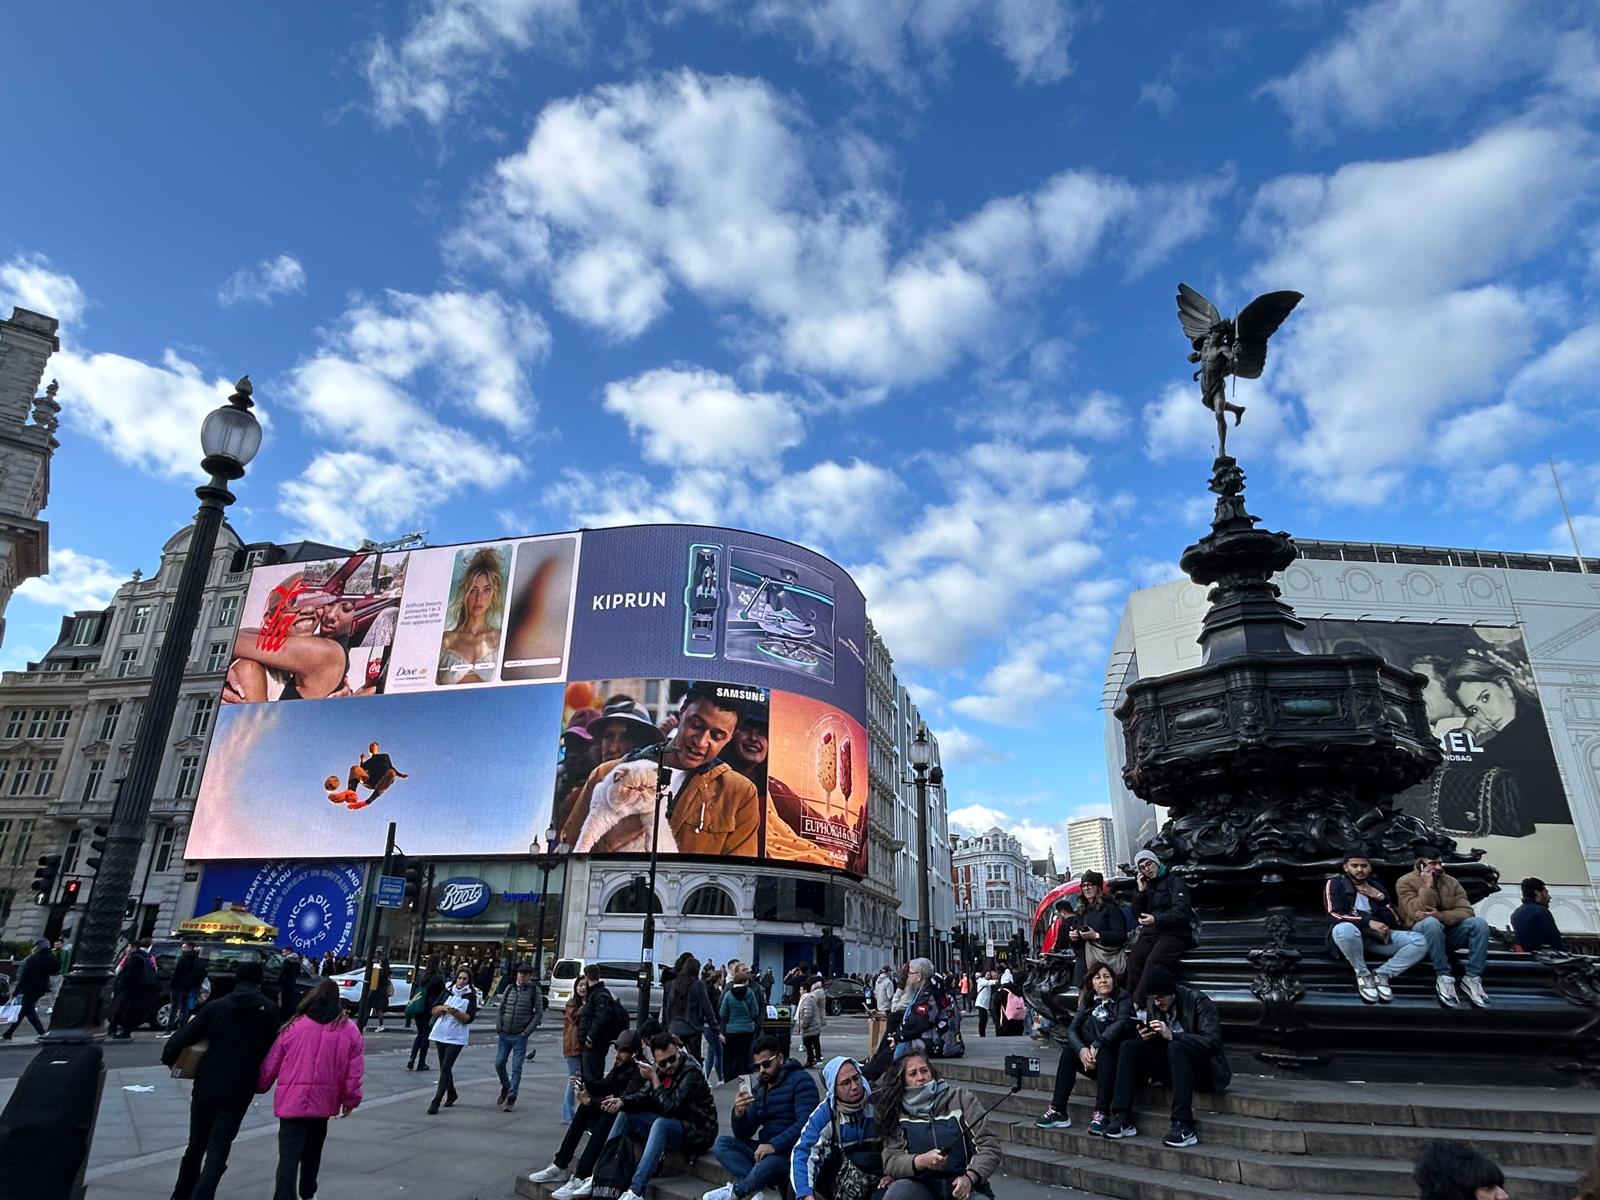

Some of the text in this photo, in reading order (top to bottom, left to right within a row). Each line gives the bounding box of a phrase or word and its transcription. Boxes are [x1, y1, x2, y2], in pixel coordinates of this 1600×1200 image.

[592, 591, 667, 611] KIPRUN
[396, 666, 418, 676] Dove
[716, 687, 766, 702] SAMSUNG
[805, 819, 842, 838] EUPHORIA
[282, 870, 310, 895] GREAT
[310, 869, 320, 877] IN
[321, 869, 350, 894] BRITAIN
[345, 869, 360, 887] AND
[260, 888, 276, 914] WITH
[274, 869, 292, 887] YOU
[437, 883, 483, 911] Boots
[288, 894, 333, 930] PICCADILLY
[200, 922, 218, 930] DOG
[288, 929, 326, 949] LIGHTS
